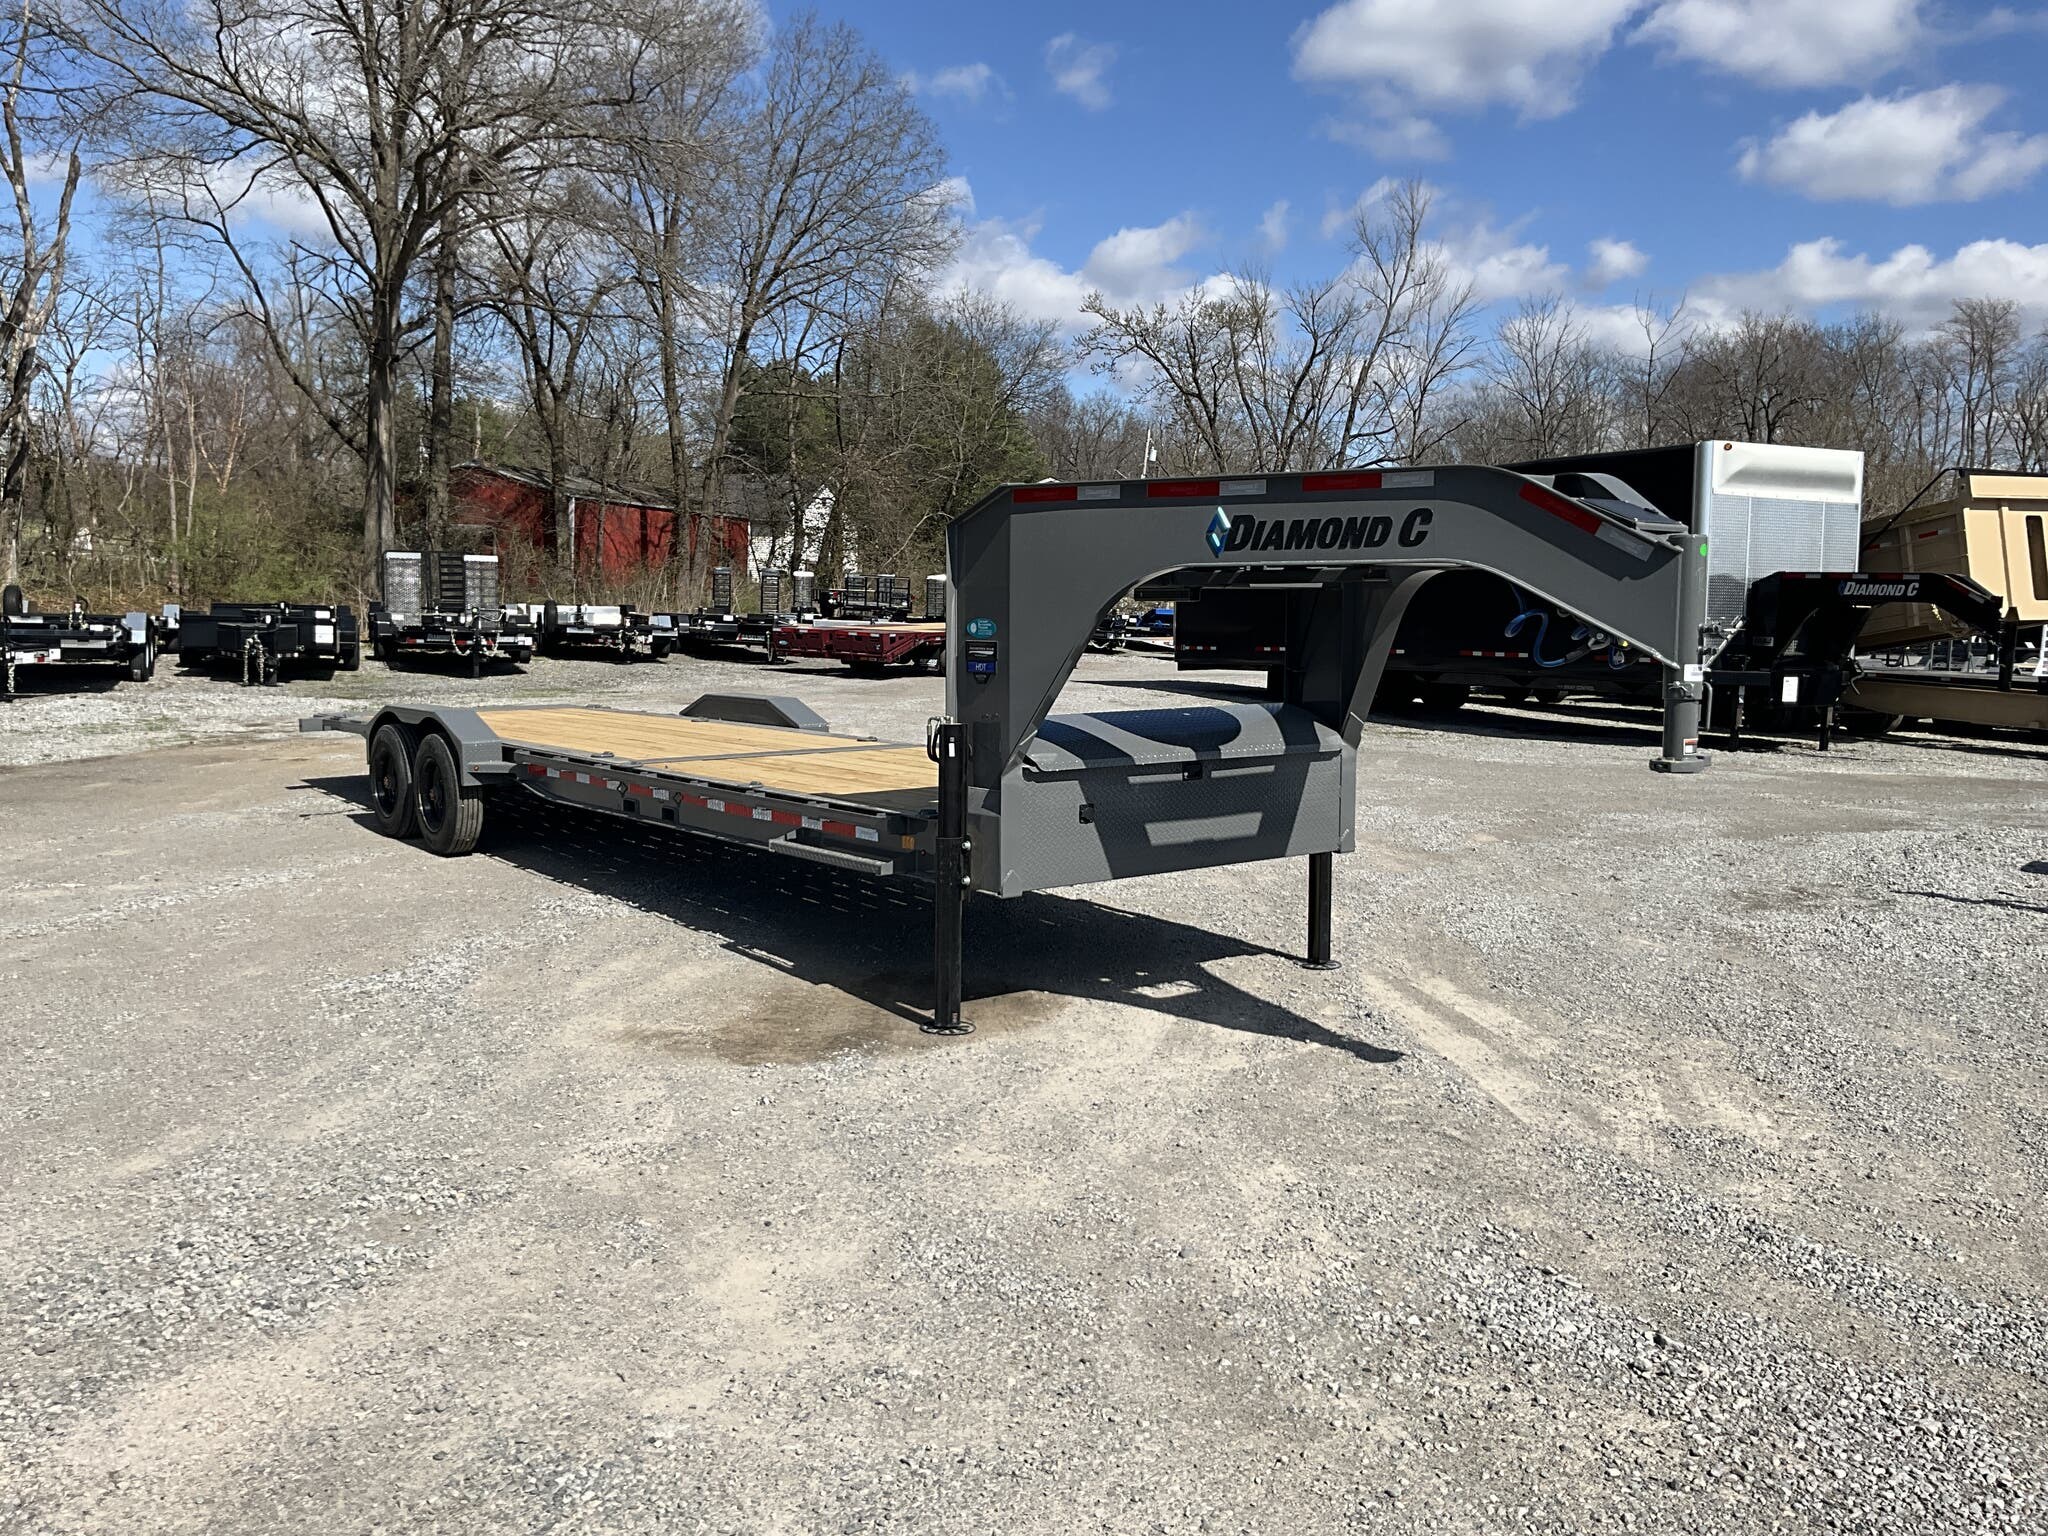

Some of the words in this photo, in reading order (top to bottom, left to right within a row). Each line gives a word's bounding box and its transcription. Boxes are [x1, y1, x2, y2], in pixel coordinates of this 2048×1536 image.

[1224, 514, 1393, 551] DIAMOND
[1398, 508, 1433, 548] C
[1843, 581, 1905, 596] DIAMOND
[1907, 582, 1919, 596] C
